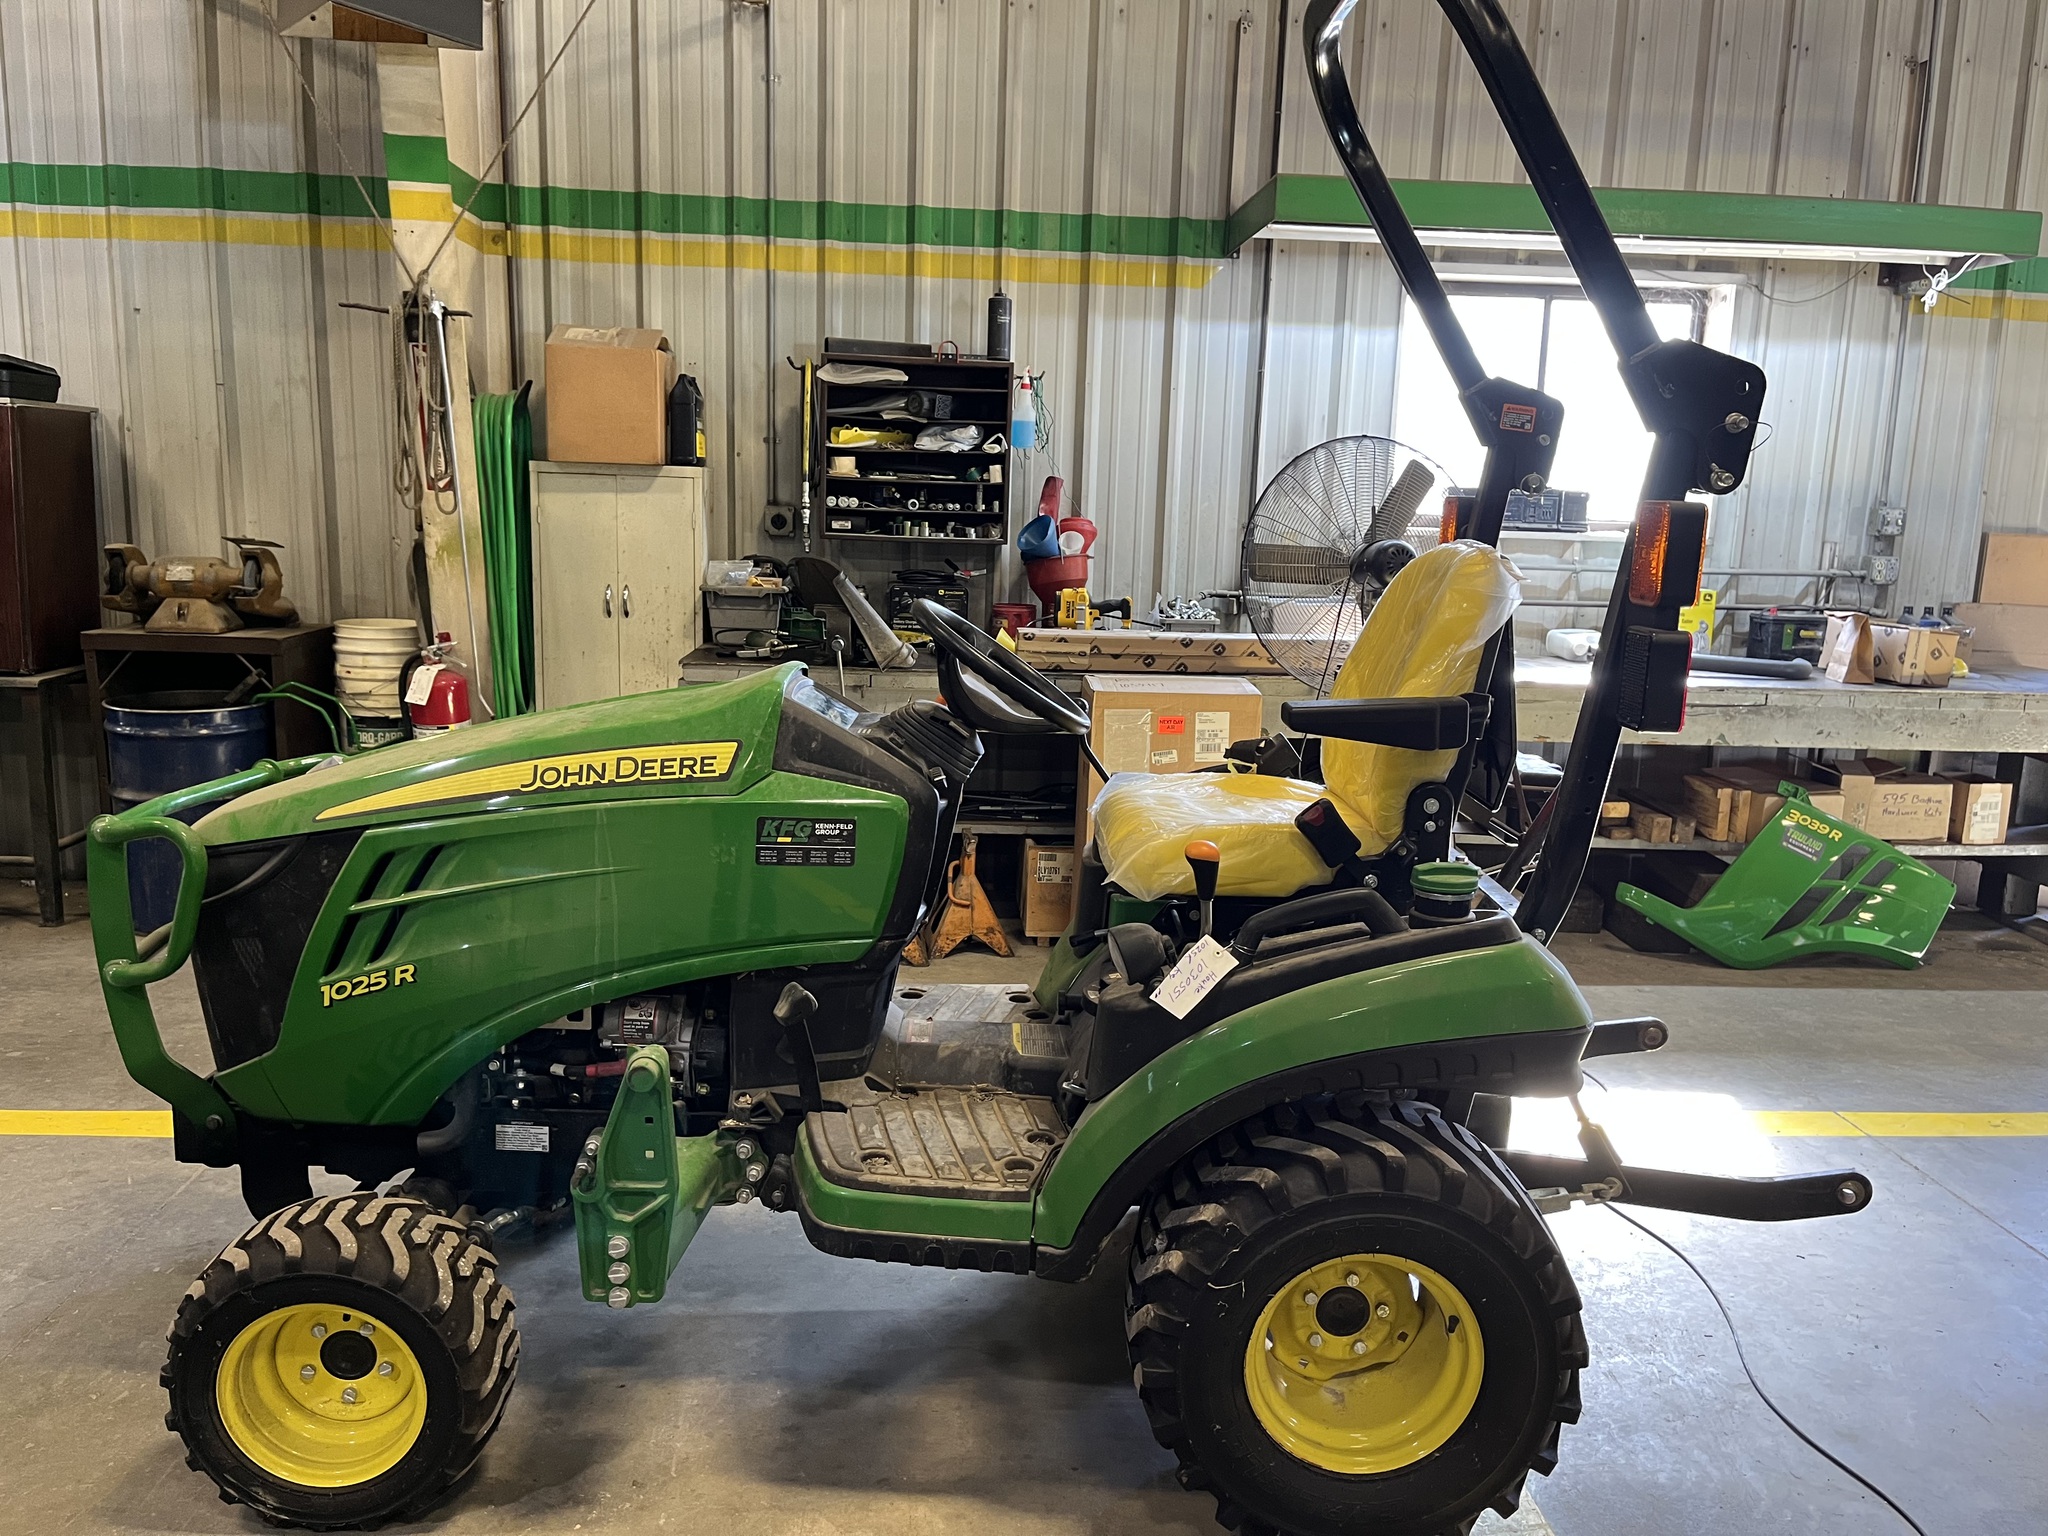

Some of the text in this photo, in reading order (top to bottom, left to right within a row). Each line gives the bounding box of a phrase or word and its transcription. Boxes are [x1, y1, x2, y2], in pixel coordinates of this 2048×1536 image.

[520, 755, 718, 790] JOHN DEERE
[1882, 792, 1909, 805] 595
[761, 820, 813, 837] KFG
[1785, 809, 1843, 842] 3039 R
[320, 964, 416, 1008] 1025 R
